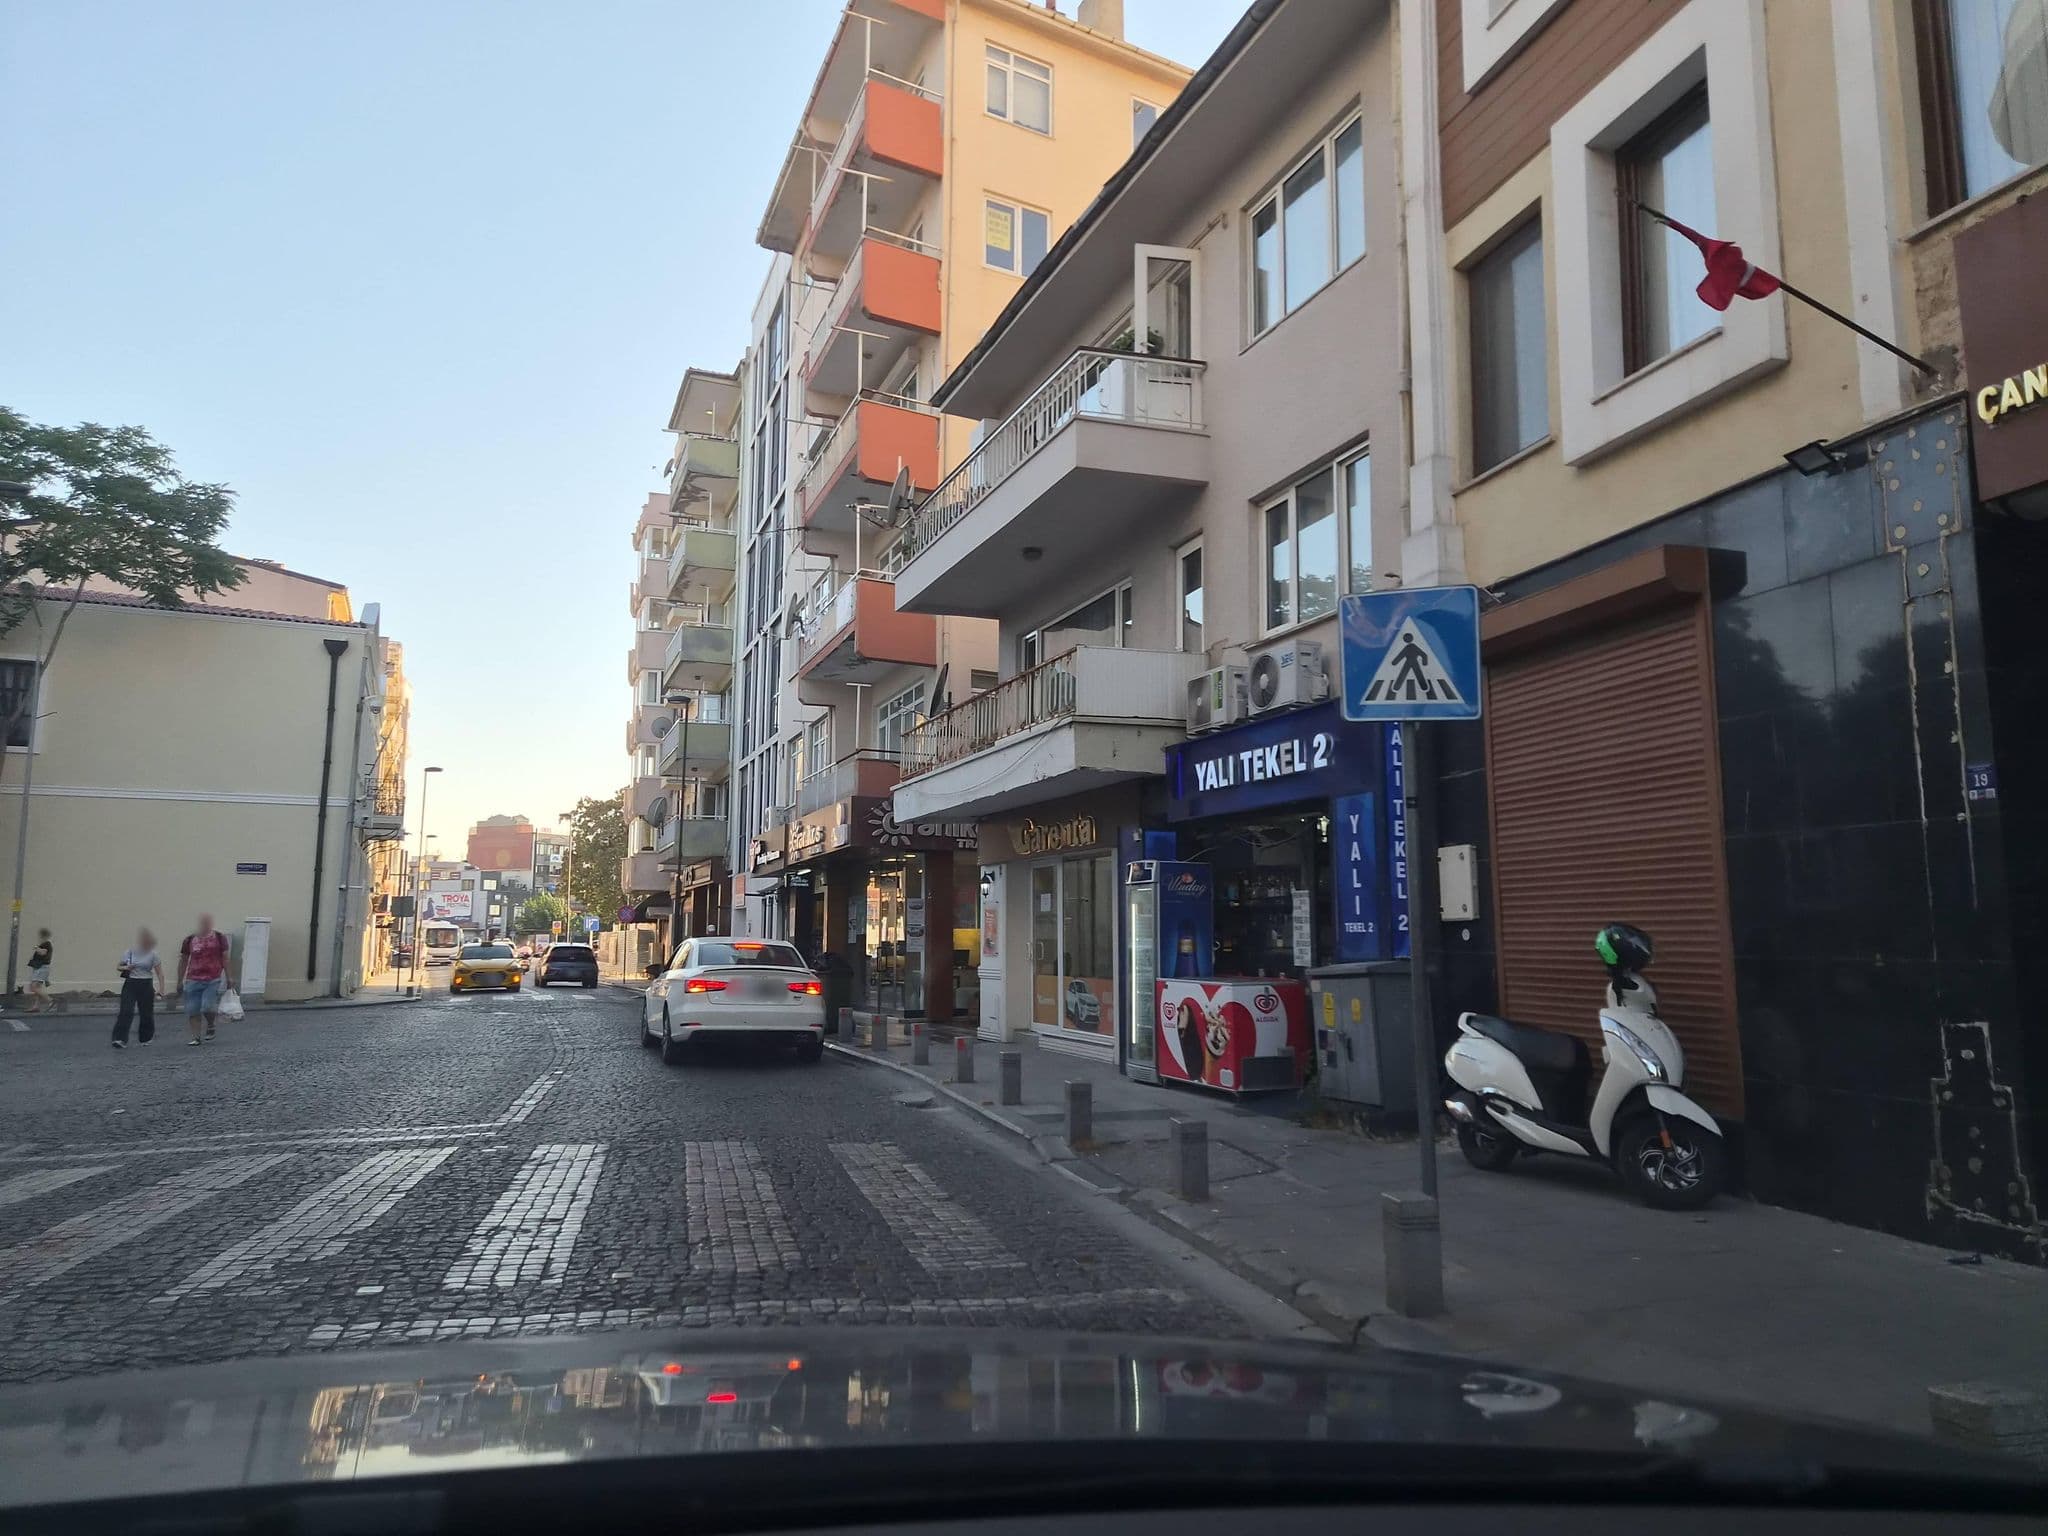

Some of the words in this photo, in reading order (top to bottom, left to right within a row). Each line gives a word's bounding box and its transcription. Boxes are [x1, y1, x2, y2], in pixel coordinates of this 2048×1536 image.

[1195, 755, 1235, 791] YALI
[1240, 739, 1307, 783] TEKEL
[1313, 732, 1330, 769] 2
[1391, 722, 1403, 787] ALI
[1974, 773, 1988, 787] 19
[1350, 814, 1362, 915] YALI
[1393, 799, 1408, 899] TEKEL
[441, 894, 470, 903] TROYA
[1345, 922, 1367, 933] TEKEL
[1368, 922, 1375, 933] 2
[1398, 915, 1409, 931] 2
